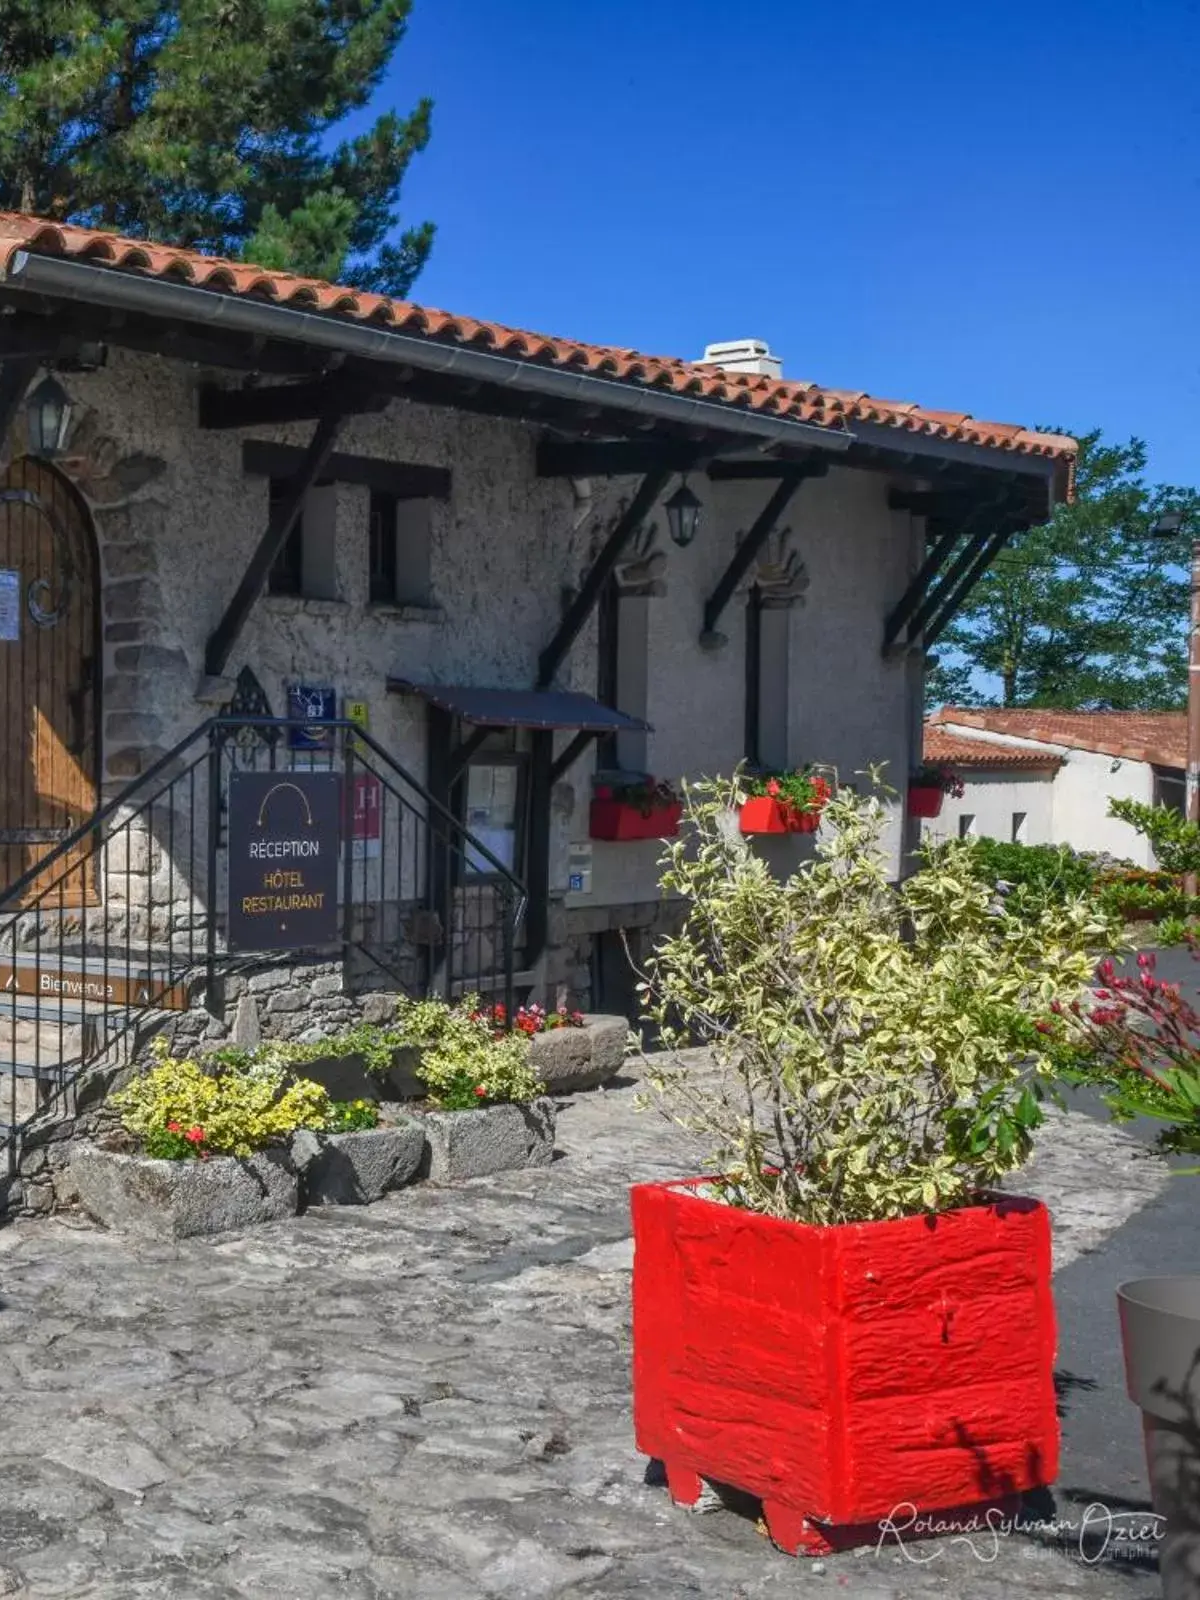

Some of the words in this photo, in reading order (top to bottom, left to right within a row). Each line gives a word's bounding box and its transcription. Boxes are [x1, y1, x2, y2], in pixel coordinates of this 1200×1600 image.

[359, 787, 377, 808] H
[250, 839, 319, 858] RÉCEPTION
[264, 869, 304, 888] HÔTEL
[243, 893, 324, 913] RESTAURANT
[41, 974, 113, 997] Bienvenue
